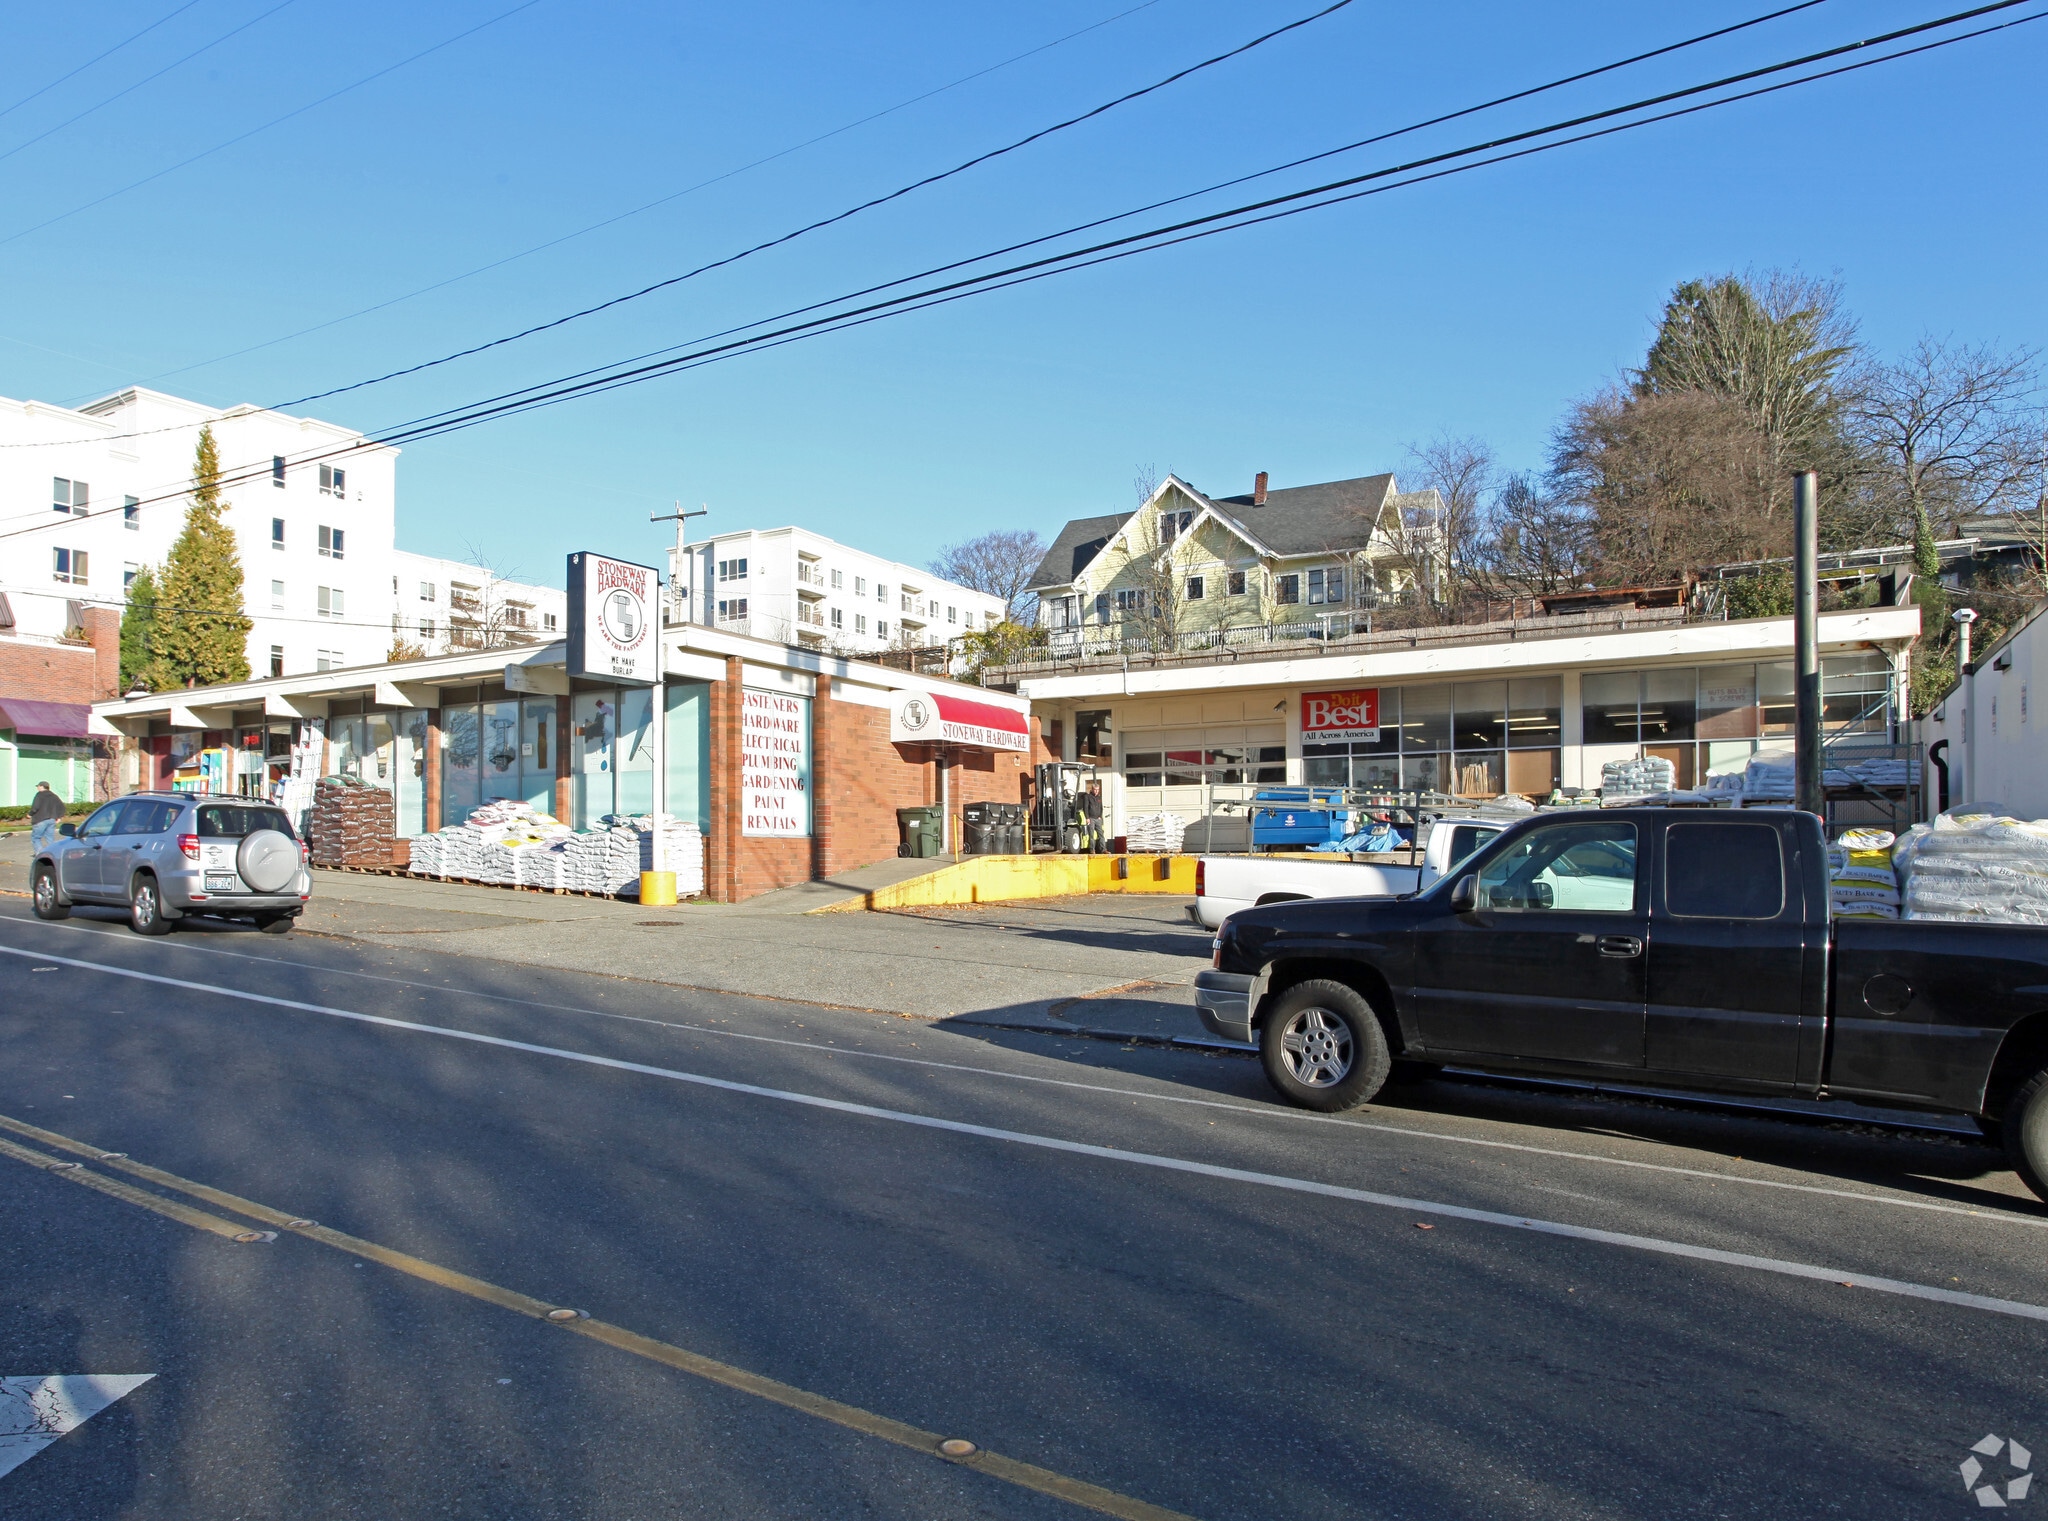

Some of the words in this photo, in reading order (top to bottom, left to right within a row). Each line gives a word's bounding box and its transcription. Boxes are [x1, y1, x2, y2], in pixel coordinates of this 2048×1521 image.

[598, 560, 646, 582] STONEWAY
[598, 573, 646, 603] HARDWARE
[598, 615, 603, 627] WE
[612, 641, 622, 651] THE
[611, 656, 619, 664] WE
[622, 657, 635, 667] HAVE
[612, 665, 634, 675] BURLAP
[742, 692, 799, 714] FASTENERS
[1331, 693, 1351, 707] Do
[1352, 692, 1361, 706] it
[1307, 699, 1372, 728] Best
[742, 713, 800, 733] HARDWARE
[942, 723, 984, 742] STONEWAY
[986, 730, 1027, 749] HARDWARE
[1305, 732, 1316, 740] All
[1318, 731, 1341, 739] Across
[1343, 730, 1374, 738] America
[742, 753, 797, 771] PLUMBING
[742, 773, 805, 791] GARDENING
[755, 795, 786, 810] PAINT
[748, 815, 797, 830] RENTALS
[1855, 888, 1875, 897] BARK
